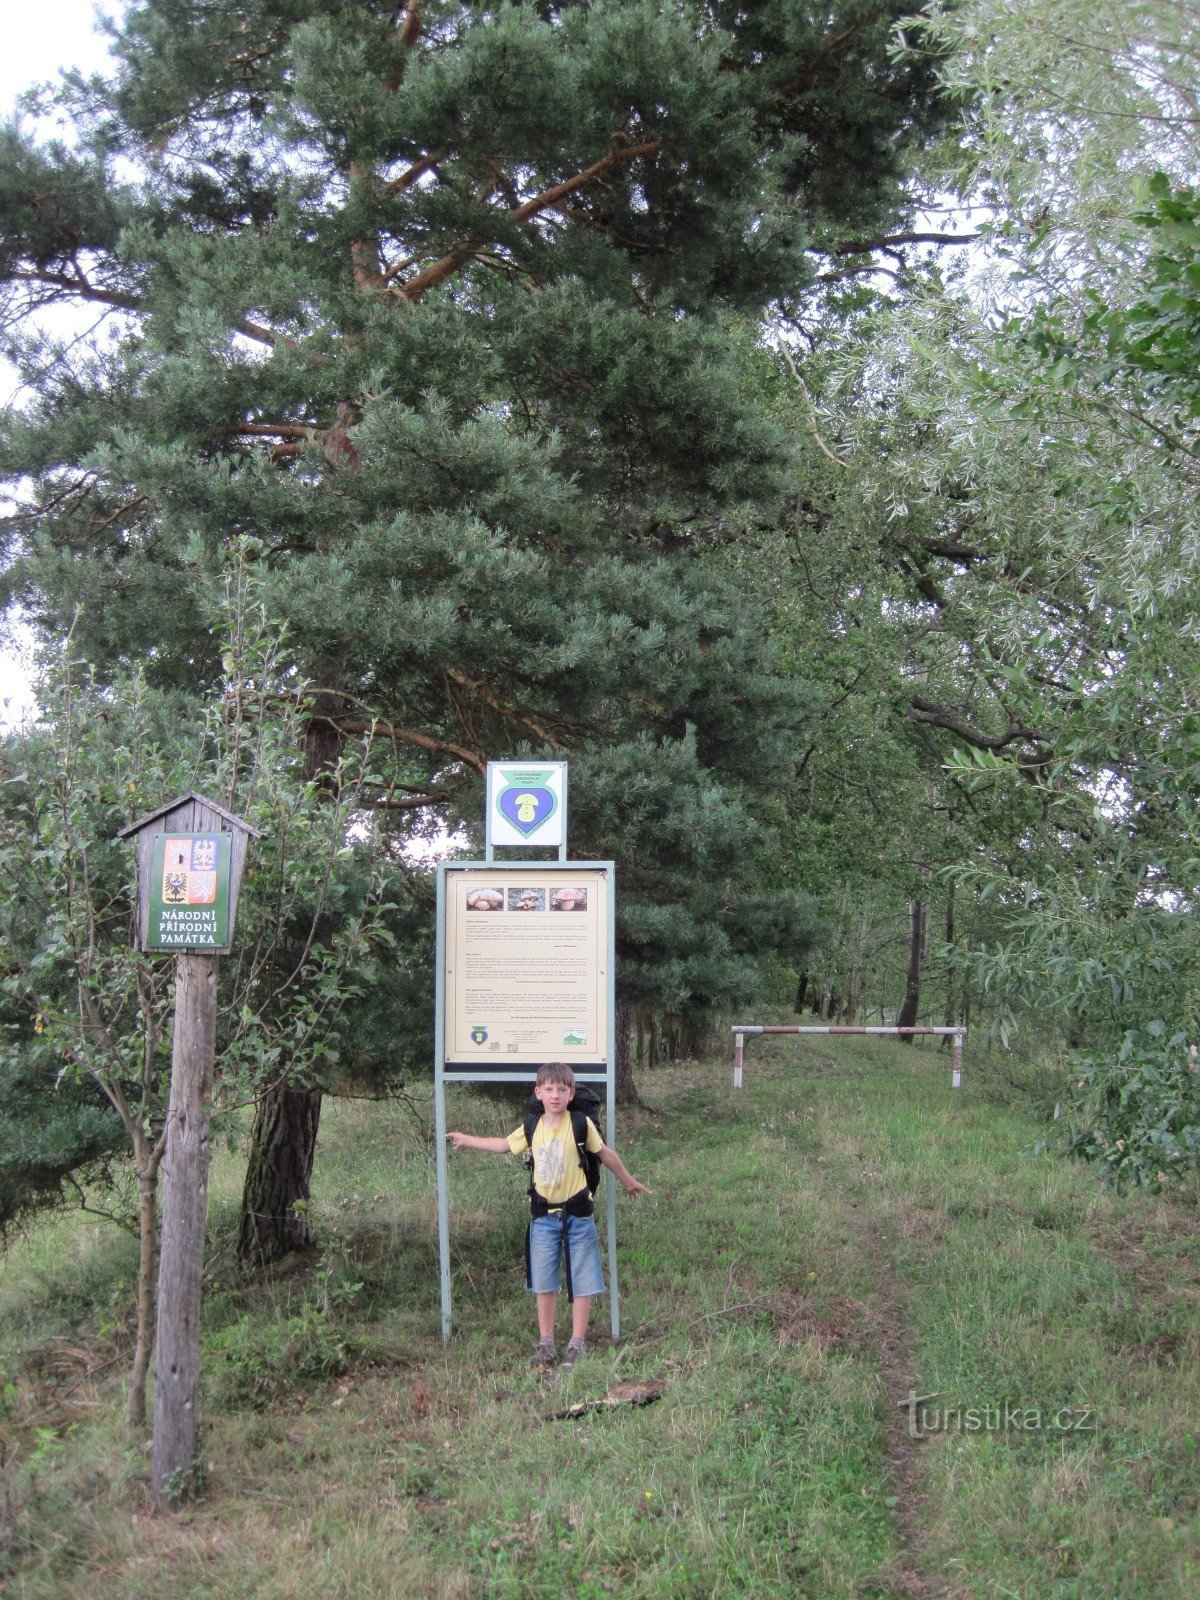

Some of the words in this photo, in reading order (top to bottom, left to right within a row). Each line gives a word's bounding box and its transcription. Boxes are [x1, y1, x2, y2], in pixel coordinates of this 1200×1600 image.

[162, 909, 216, 920] NÁRODNÍ
[159, 921, 217, 932] PŘÍRODNÍ
[160, 932, 215, 943] PAMÁTKA
